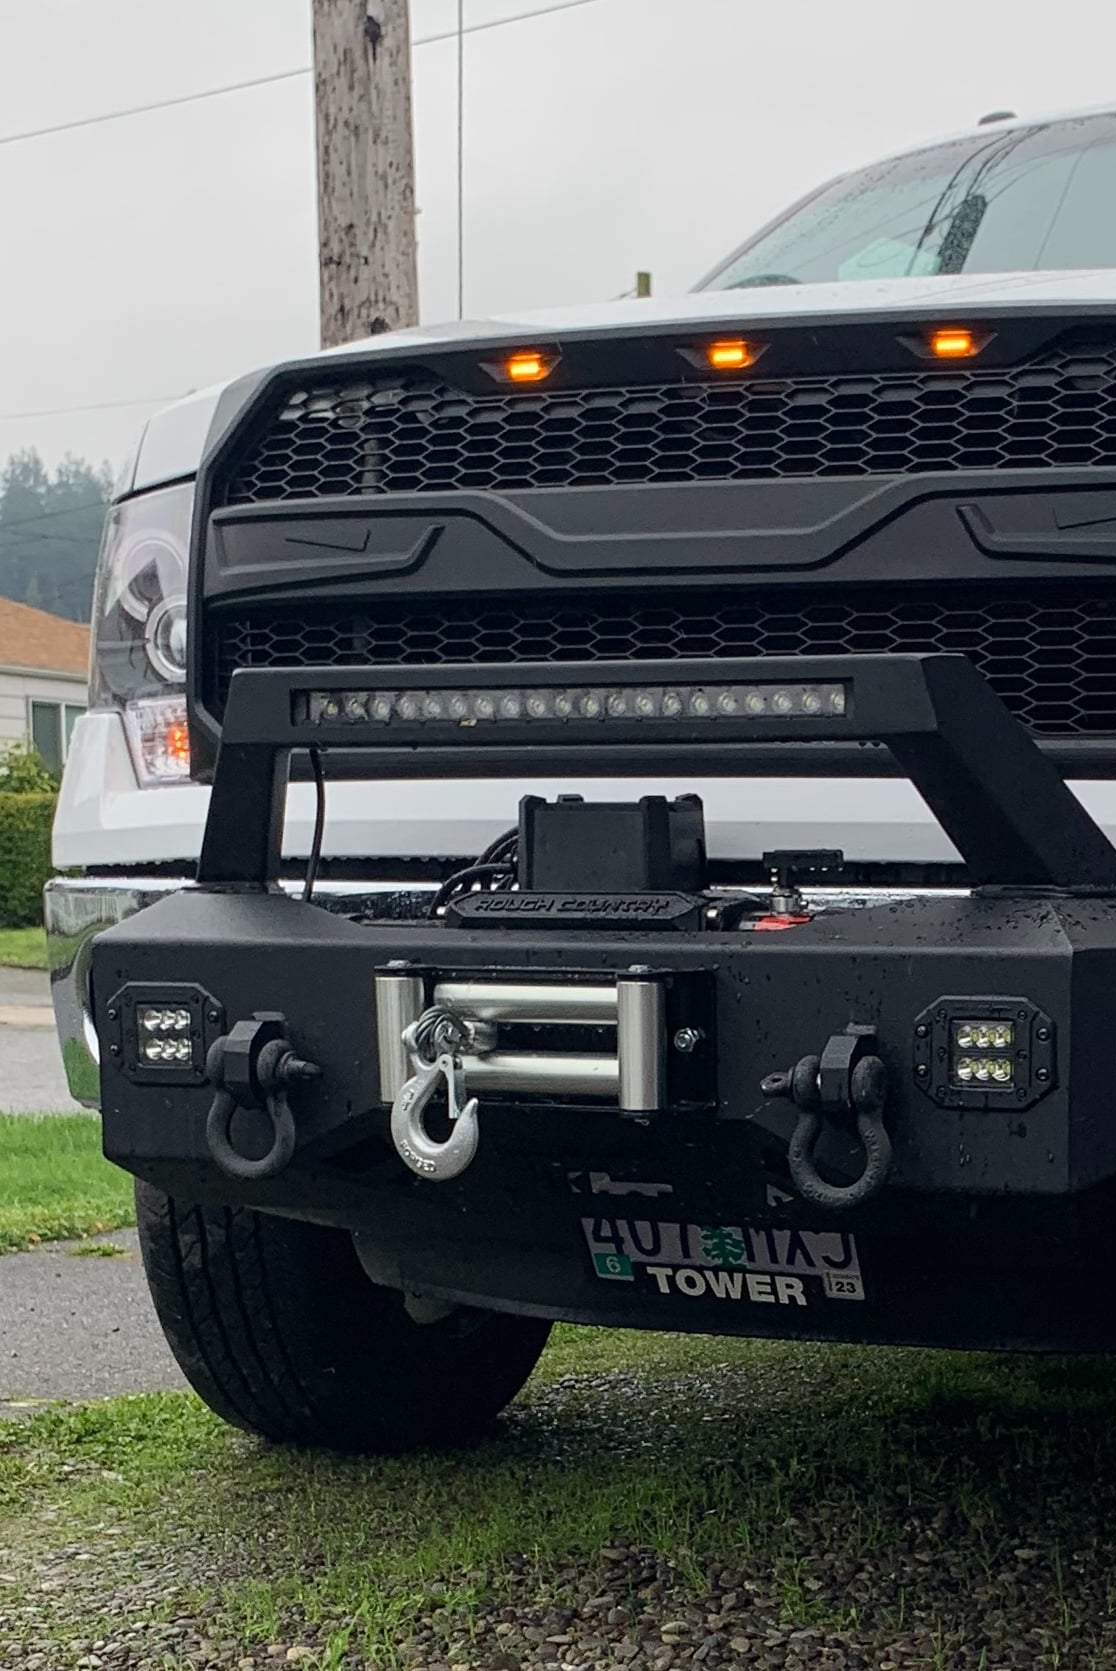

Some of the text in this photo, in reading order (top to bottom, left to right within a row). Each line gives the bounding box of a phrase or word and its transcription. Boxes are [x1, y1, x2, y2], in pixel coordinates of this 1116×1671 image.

[474, 898, 671, 917] ROUGH COUNTRY
[606, 1255, 621, 1273] 6
[646, 1266, 808, 1306] TOWER
[835, 1281, 857, 1293] 23
